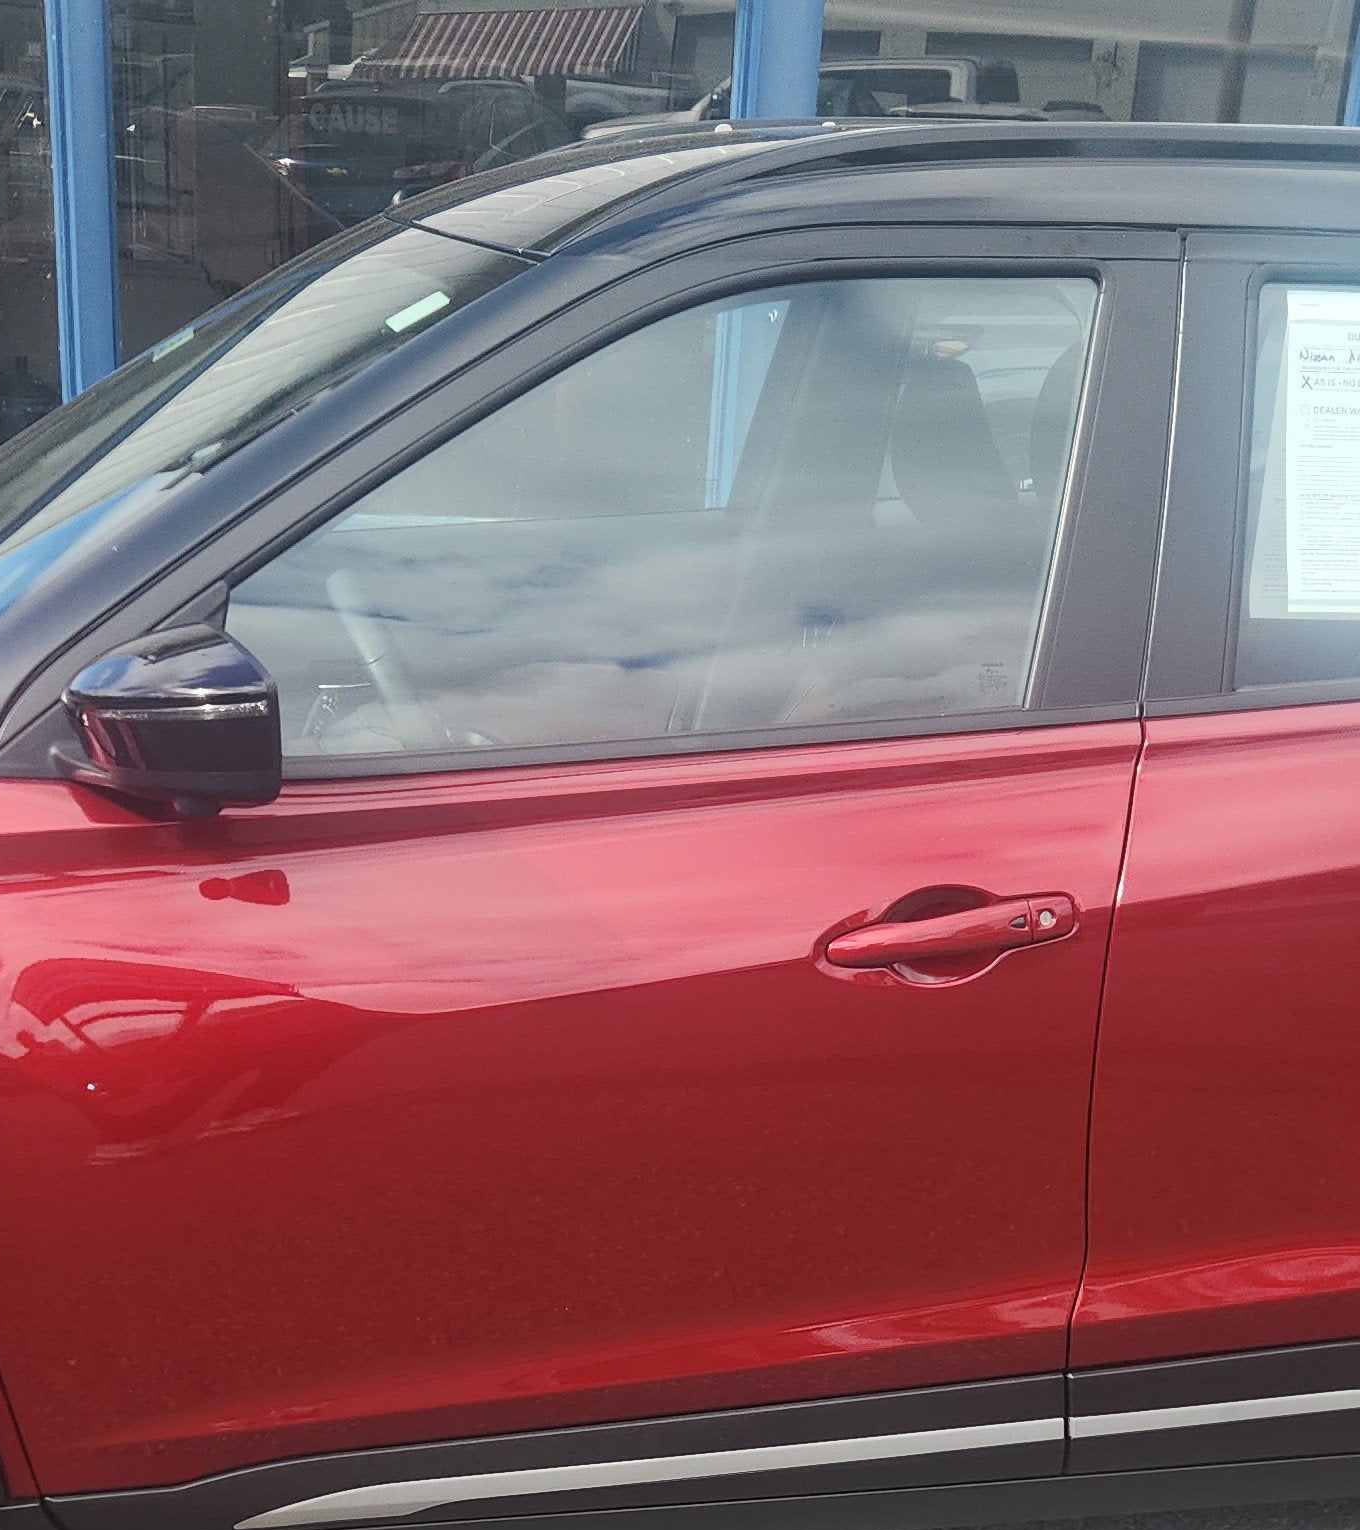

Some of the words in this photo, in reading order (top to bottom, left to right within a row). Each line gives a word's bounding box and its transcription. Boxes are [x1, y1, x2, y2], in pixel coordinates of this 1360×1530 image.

[1299, 347, 1336, 362] Nissan
[1314, 379, 1326, 387] AS
[1327, 379, 1336, 387] IS
[1343, 379, 1356, 388] NO
[1313, 406, 1348, 416] DEALER
